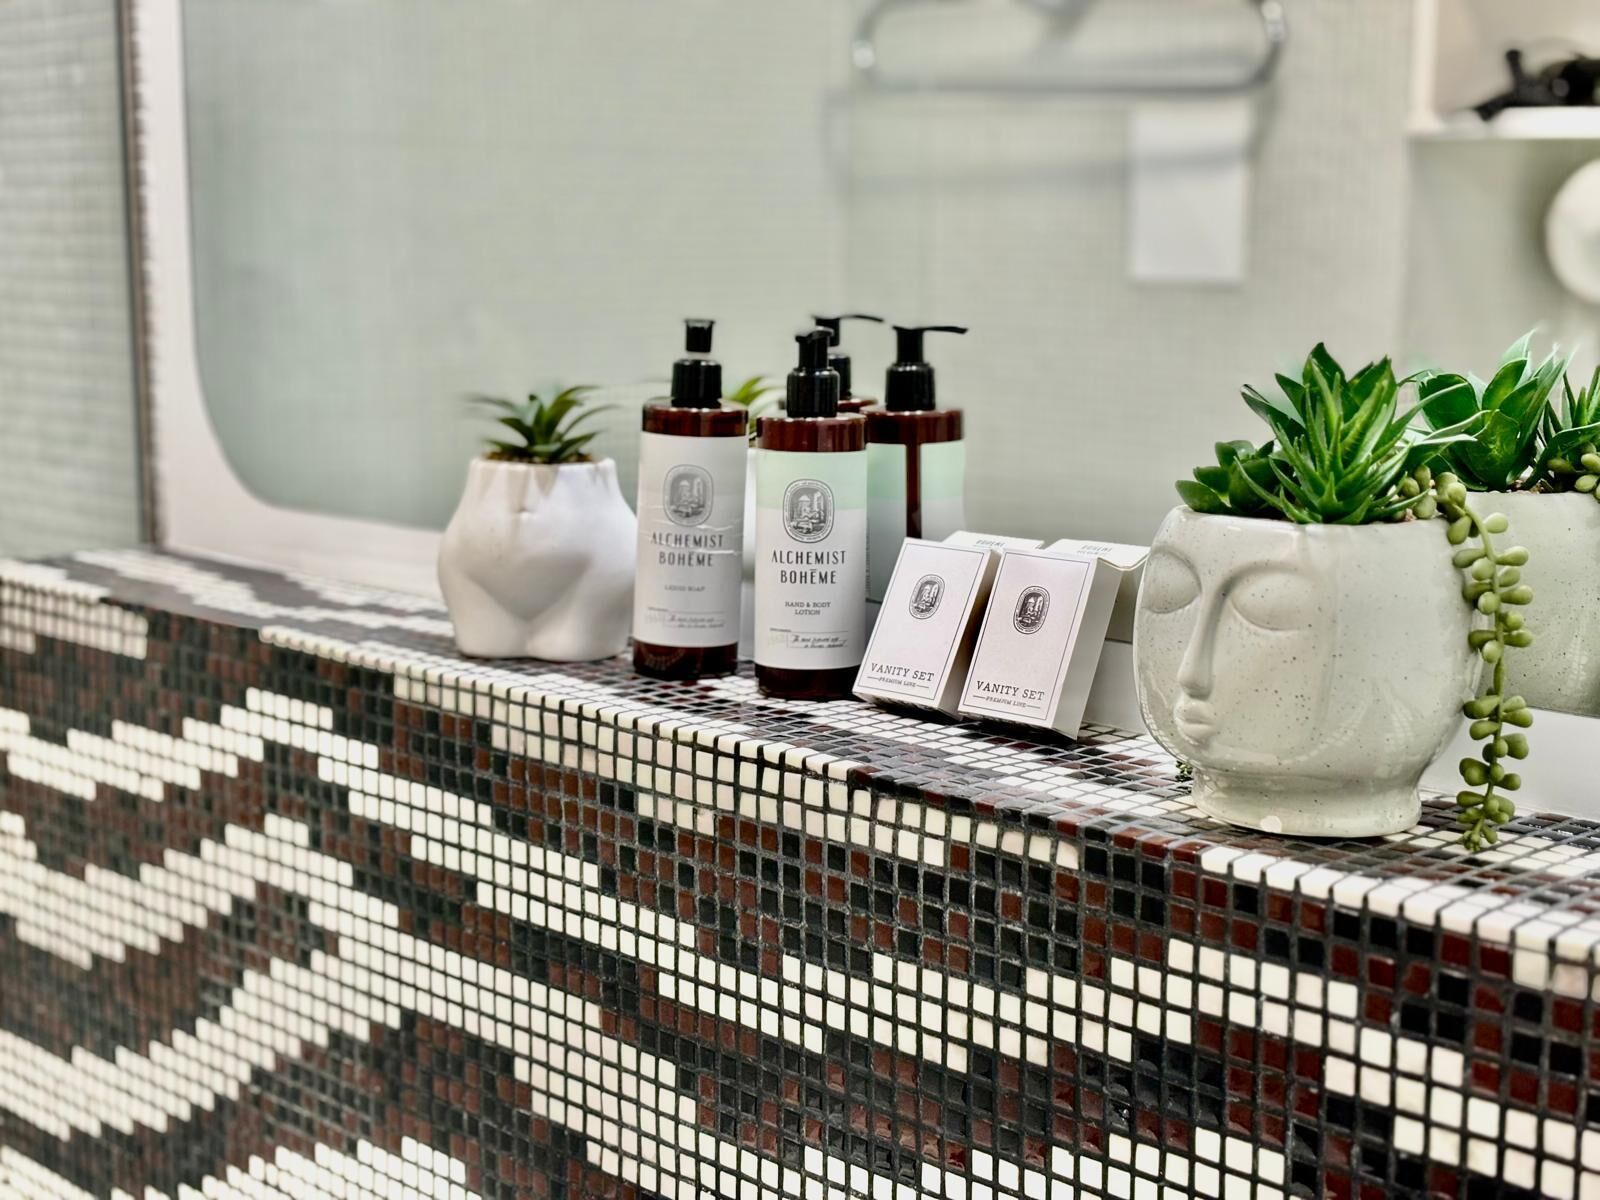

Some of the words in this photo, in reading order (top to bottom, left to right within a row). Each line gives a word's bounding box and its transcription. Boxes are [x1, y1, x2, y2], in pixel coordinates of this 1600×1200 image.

[651, 531, 724, 548] ALCHEMIST
[771, 550, 846, 565] ALCHEMIST
[871, 662, 910, 677] VANITY
[912, 670, 935, 682] SET
[977, 680, 1019, 697] VANITY
[1022, 689, 1045, 701] SET
[985, 696, 1012, 705] PREMIUM
